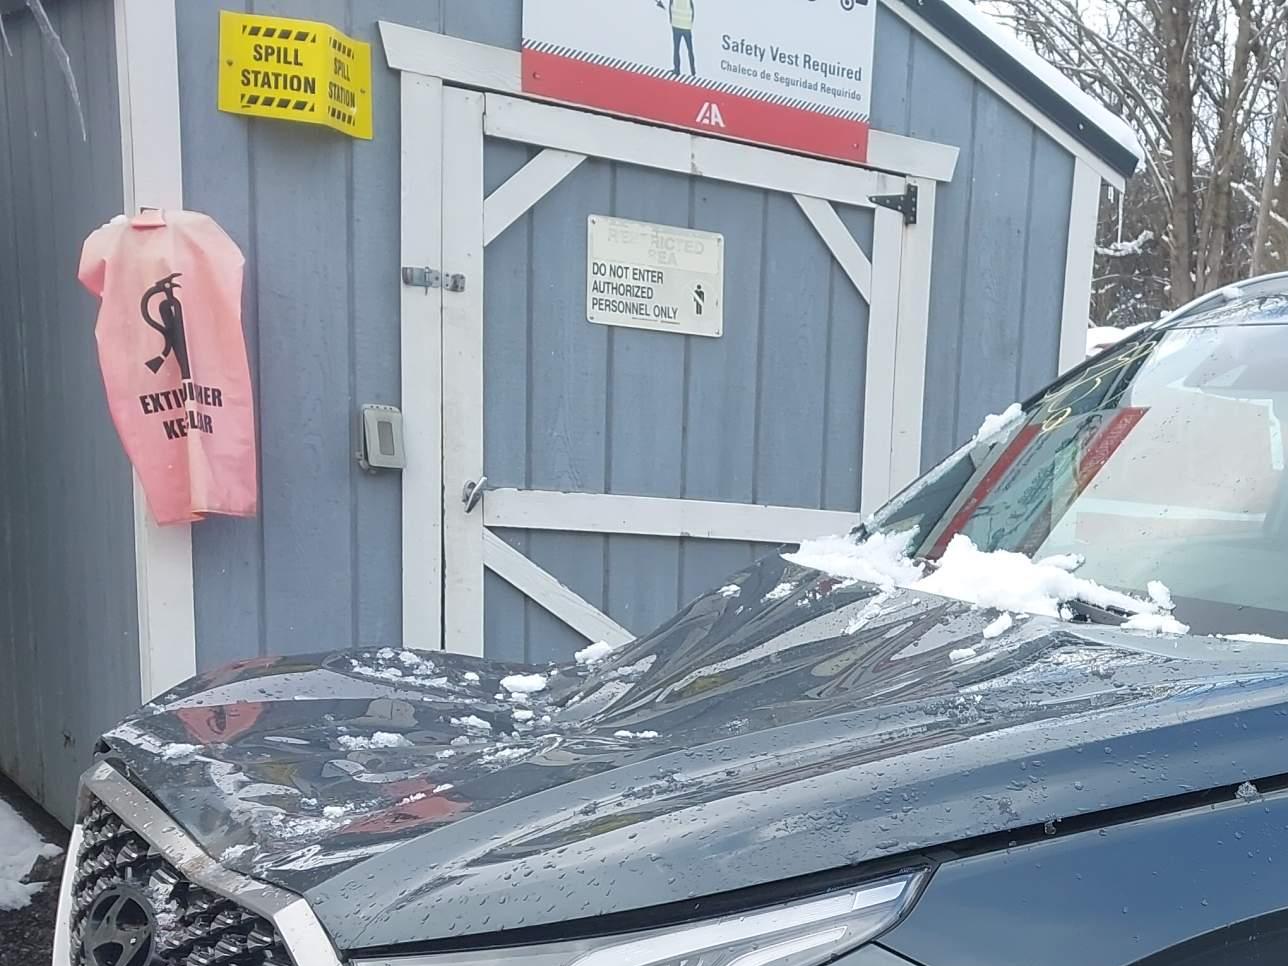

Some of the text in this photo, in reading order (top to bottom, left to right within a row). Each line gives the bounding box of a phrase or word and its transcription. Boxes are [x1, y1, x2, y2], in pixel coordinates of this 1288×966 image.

[253, 43, 303, 66] SPILL
[721, 34, 862, 81] Safety Vest Required
[241, 69, 316, 94] STATION
[333, 57, 351, 82] SPILL
[720, 60, 862, 101] Chaleco de Seguridad Requirido
[328, 82, 356, 108] STATION
[592, 262, 664, 284] DO NOT ENTER
[592, 279, 654, 300] AUTHORIZED
[591, 297, 679, 320] PERSONNEL ONLY
